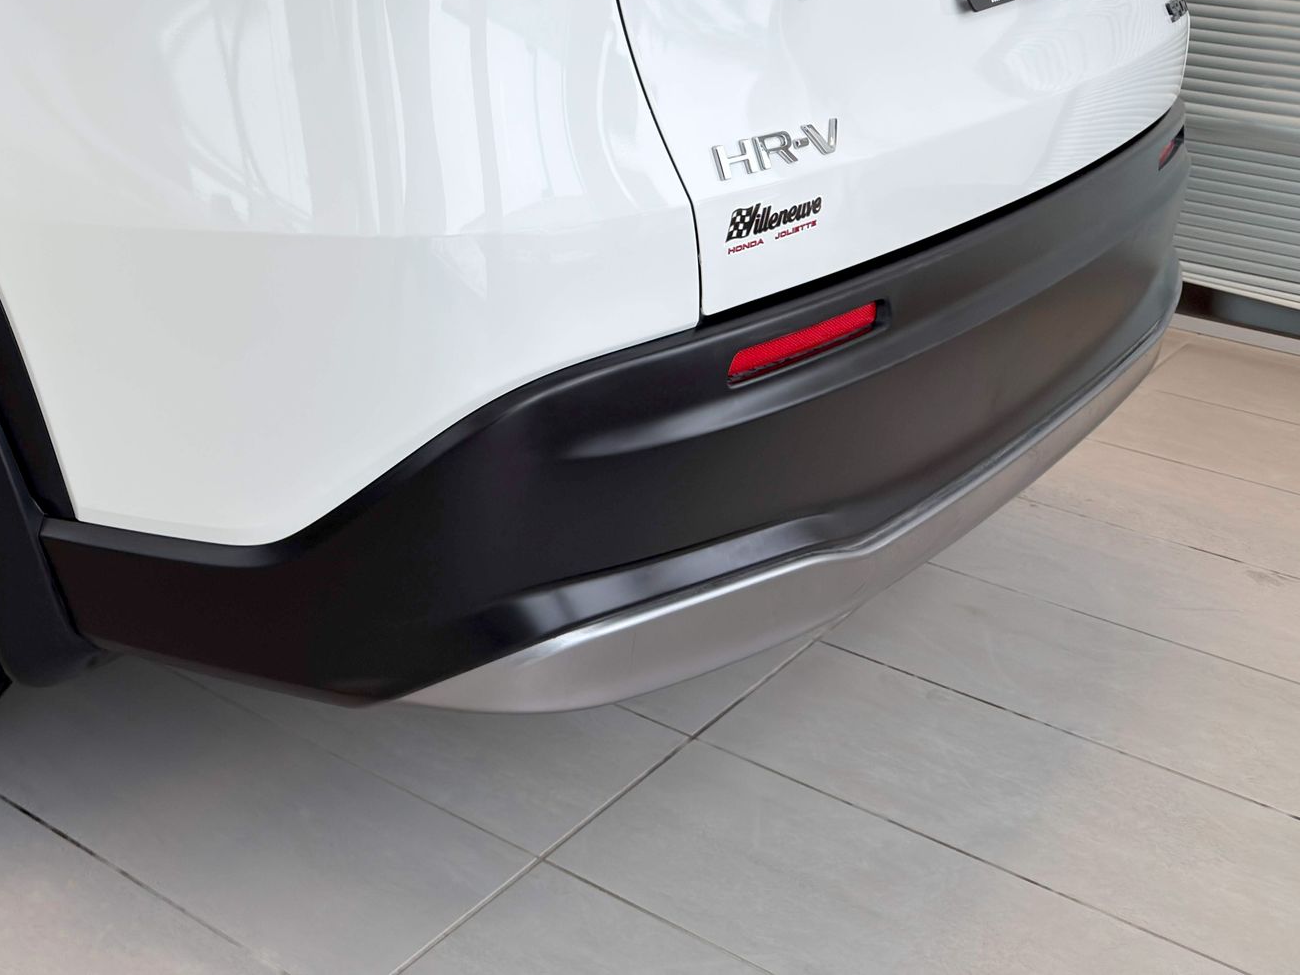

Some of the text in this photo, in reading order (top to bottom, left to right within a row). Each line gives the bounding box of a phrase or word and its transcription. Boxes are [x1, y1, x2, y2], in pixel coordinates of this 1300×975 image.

[711, 117, 838, 181] HR-V
[725, 196, 822, 243] Villeneuve
[727, 219, 818, 255] HONDA JOLIETTE
